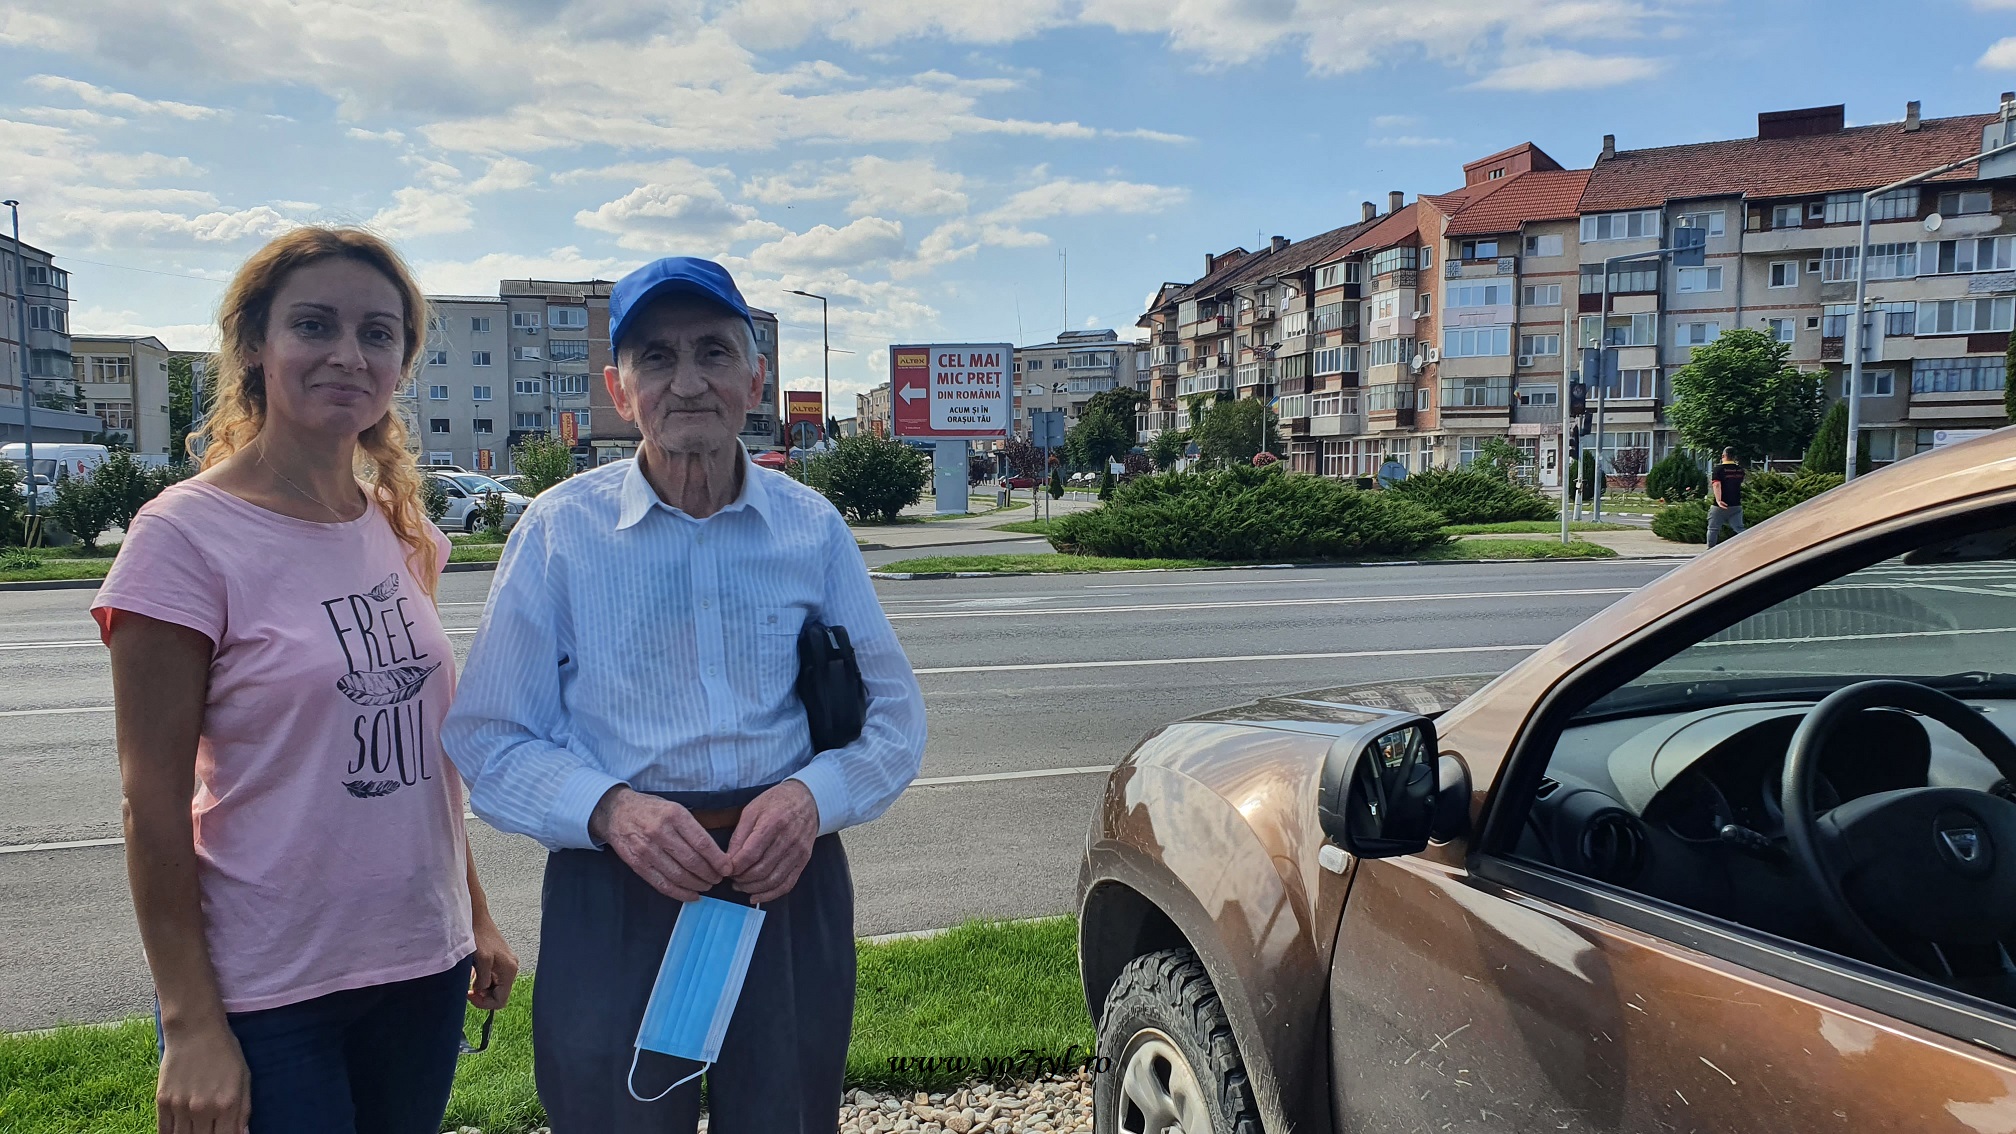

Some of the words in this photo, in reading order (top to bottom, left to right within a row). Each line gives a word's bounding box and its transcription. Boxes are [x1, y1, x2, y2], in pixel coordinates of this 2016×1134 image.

[938, 353, 965, 368] CEL
[969, 353, 1000, 368] MAI
[936, 372, 963, 385] MIC
[937, 390, 953, 400] DIN
[956, 388, 1001, 400] ROMÂNIA
[949, 406, 970, 414] ACUM
[981, 405, 989, 414] ÎN
[977, 415, 991, 423] TĂU
[321, 594, 428, 674] FREE
[347, 699, 432, 787] SOUL
